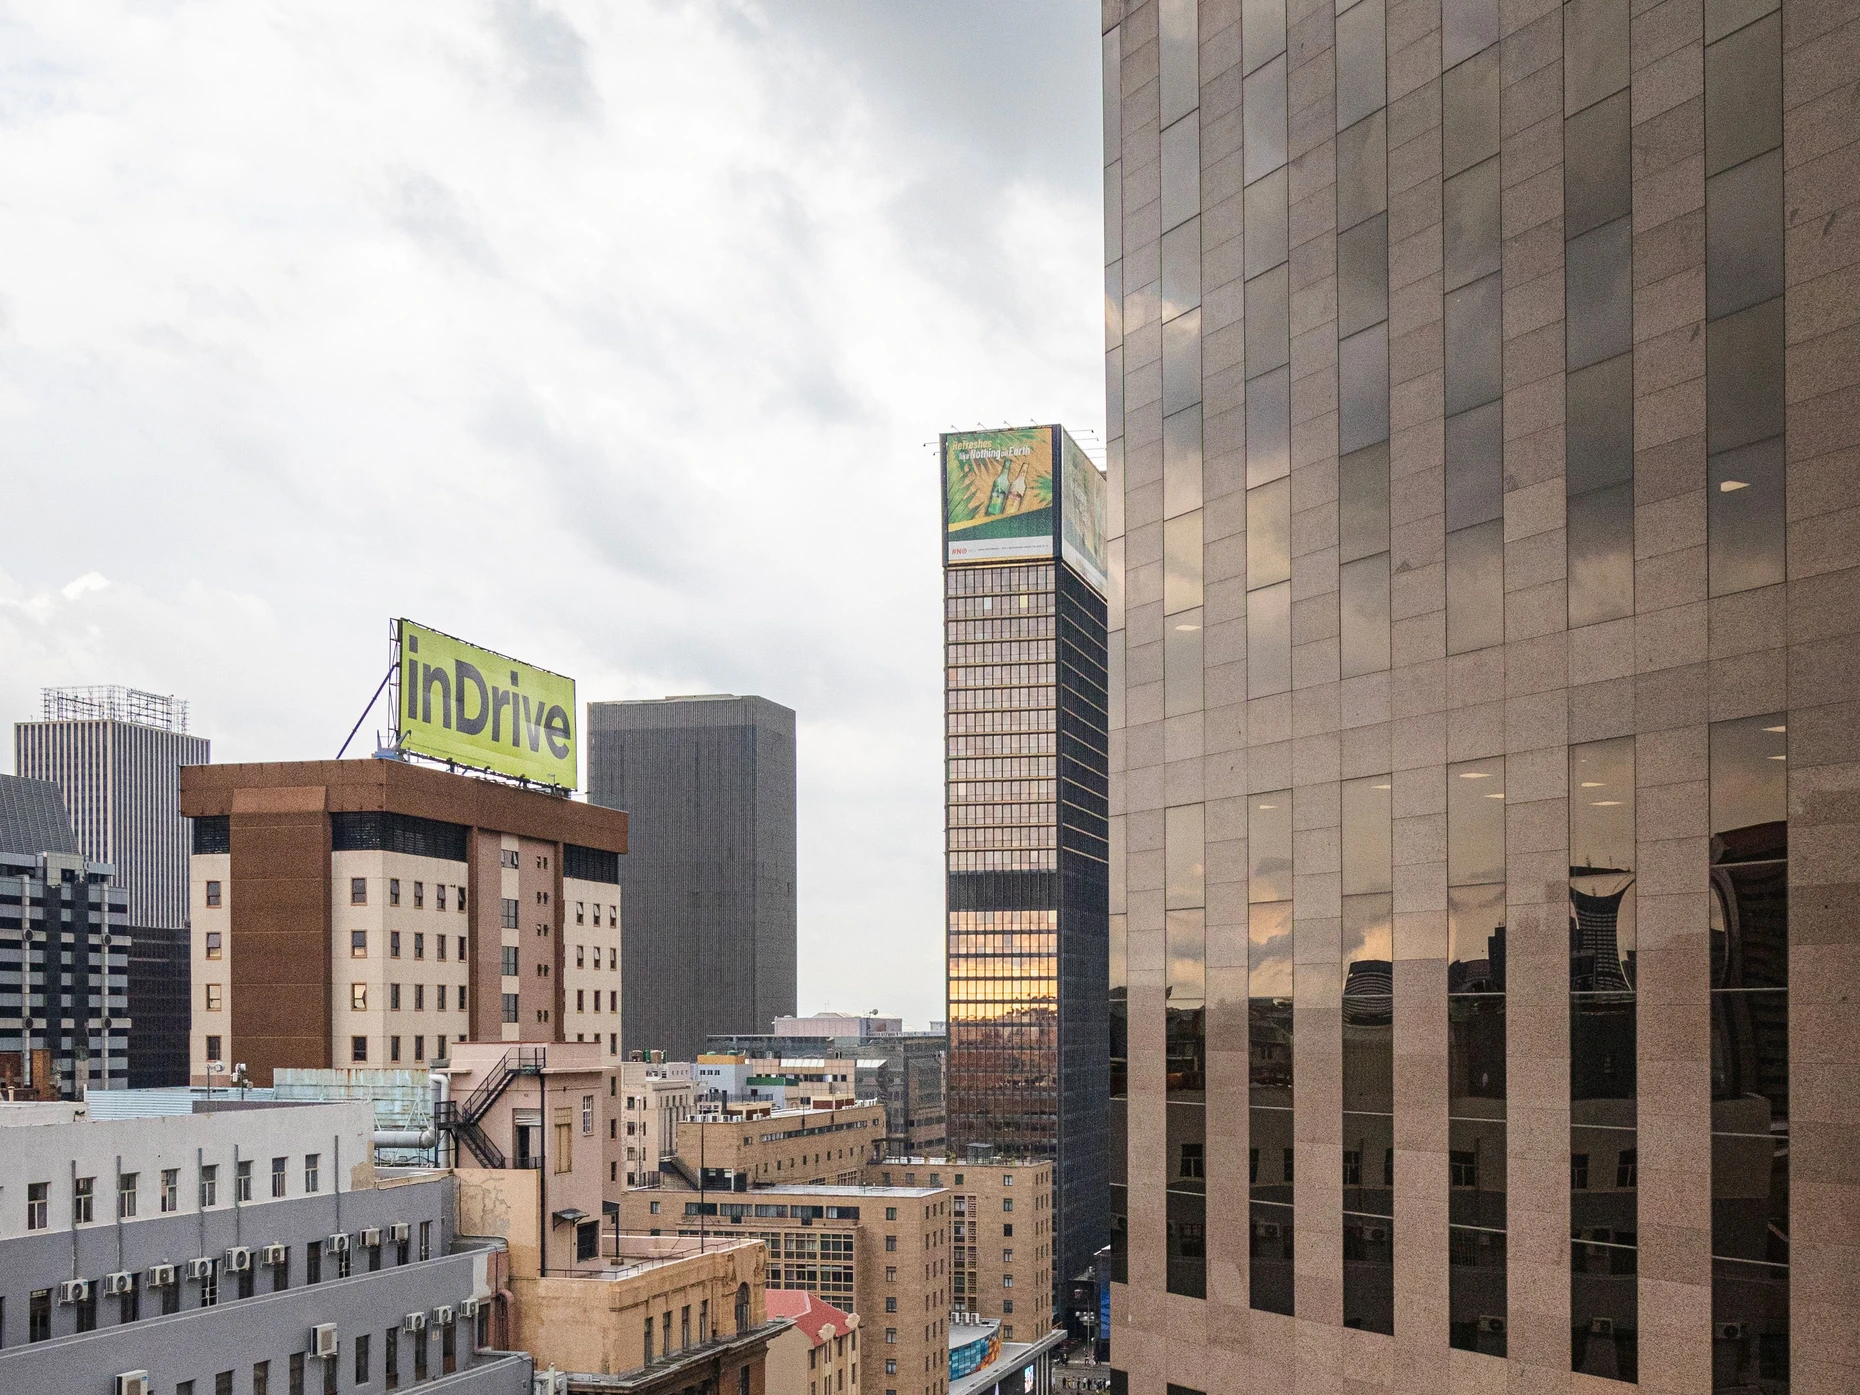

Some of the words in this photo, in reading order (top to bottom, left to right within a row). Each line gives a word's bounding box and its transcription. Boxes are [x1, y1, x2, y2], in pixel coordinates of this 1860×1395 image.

[952, 439, 992, 450] Refreshes
[970, 448, 1001, 460] Nothing
[1009, 445, 1031, 456] Earth
[407, 634, 571, 760] inDrive
